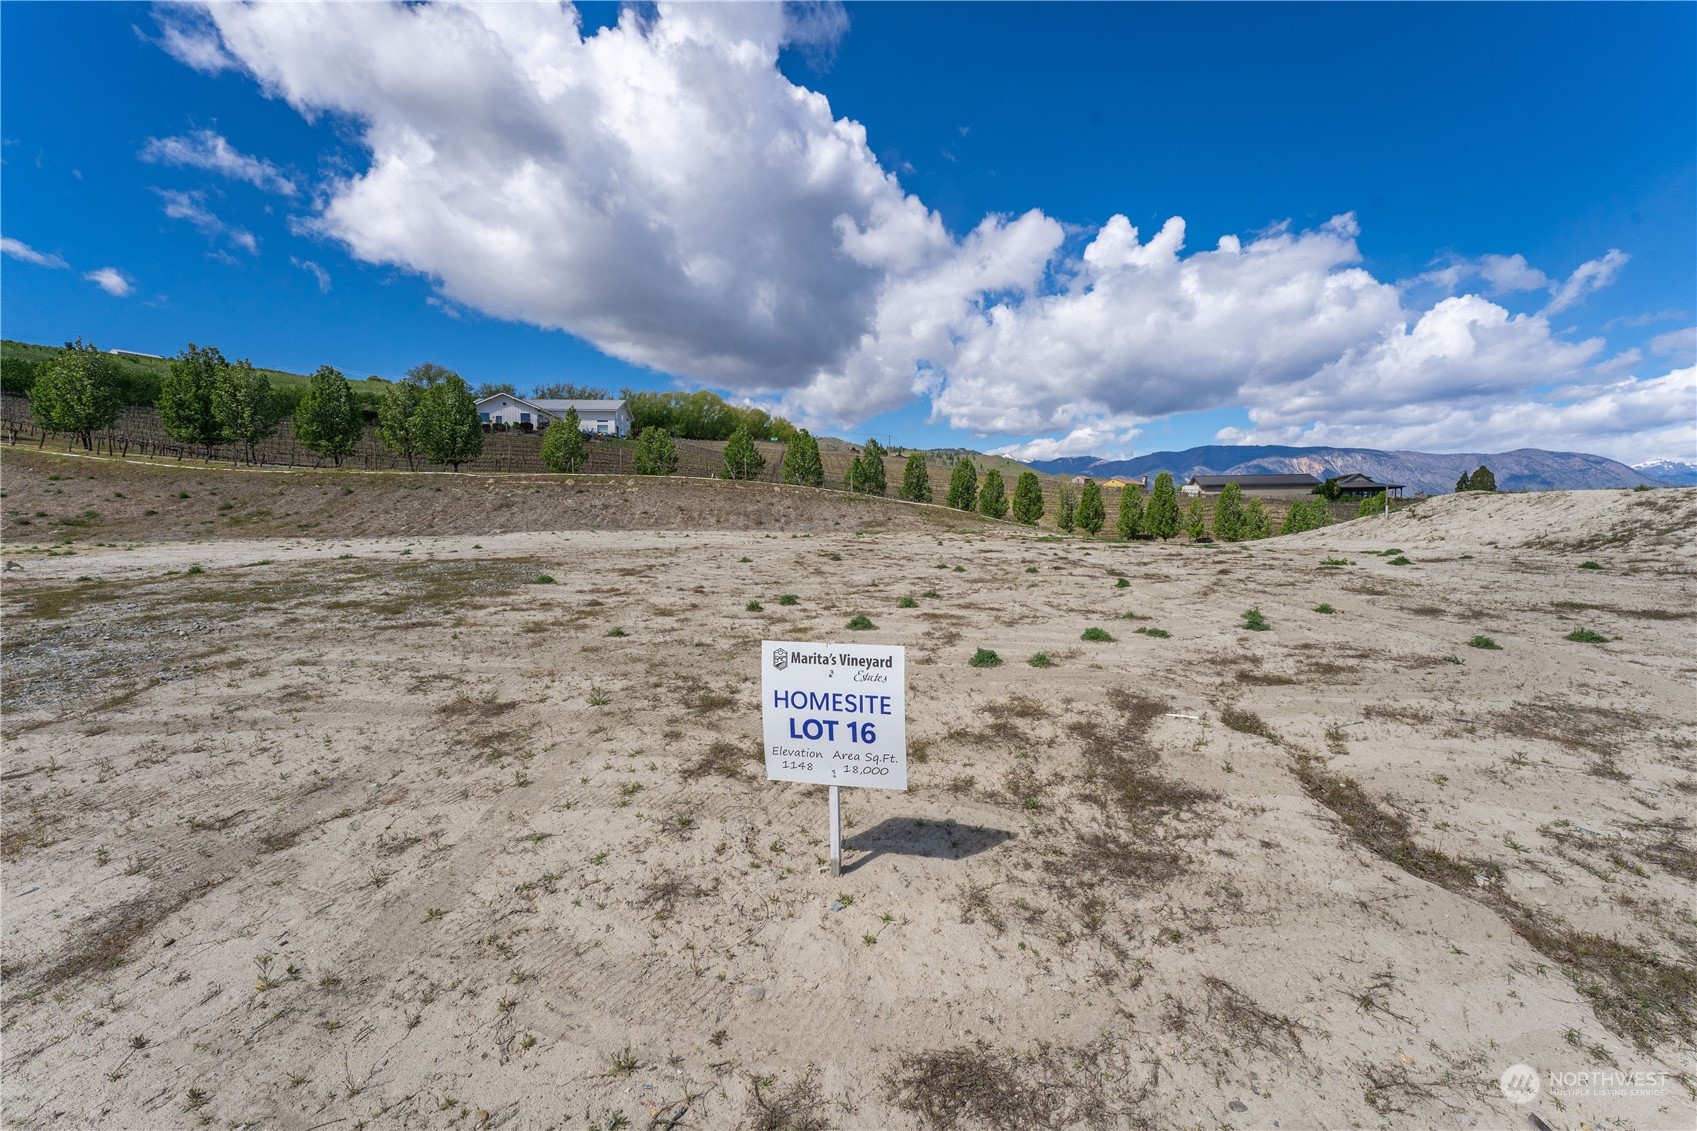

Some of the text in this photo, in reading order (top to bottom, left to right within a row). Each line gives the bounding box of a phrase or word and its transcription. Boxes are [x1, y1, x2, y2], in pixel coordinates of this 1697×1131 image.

[791, 652, 892, 670] Marita's Vineyard
[853, 670, 887, 683] Estates
[774, 690, 891, 715] HOMESITE
[789, 717, 876, 744] LOT 16
[772, 746, 823, 759] Elevation
[832, 750, 898, 765] Area Sq.Ft.
[782, 760, 813, 770] 1148
[843, 764, 889, 776] 18,000
